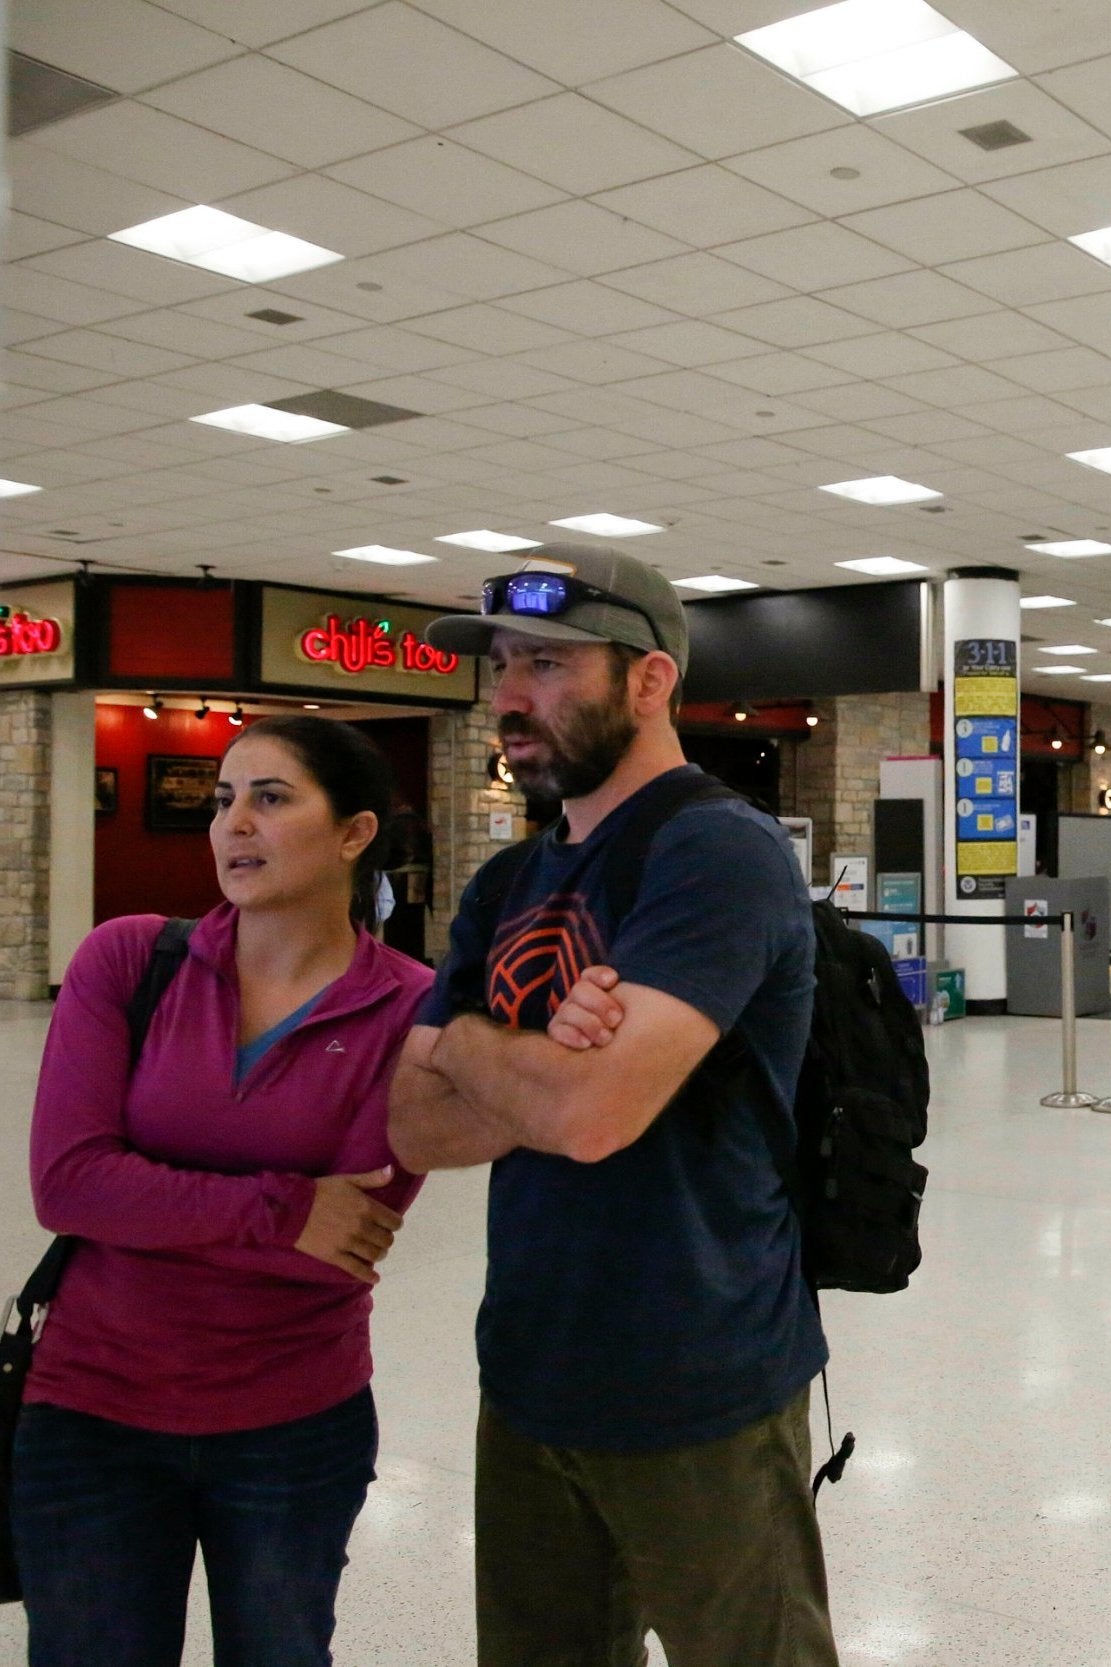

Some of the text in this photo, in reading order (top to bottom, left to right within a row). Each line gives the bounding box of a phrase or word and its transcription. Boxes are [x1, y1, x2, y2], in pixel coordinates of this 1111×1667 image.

[12, 612, 60, 654] too
[302, 614, 457, 673] chili's too
